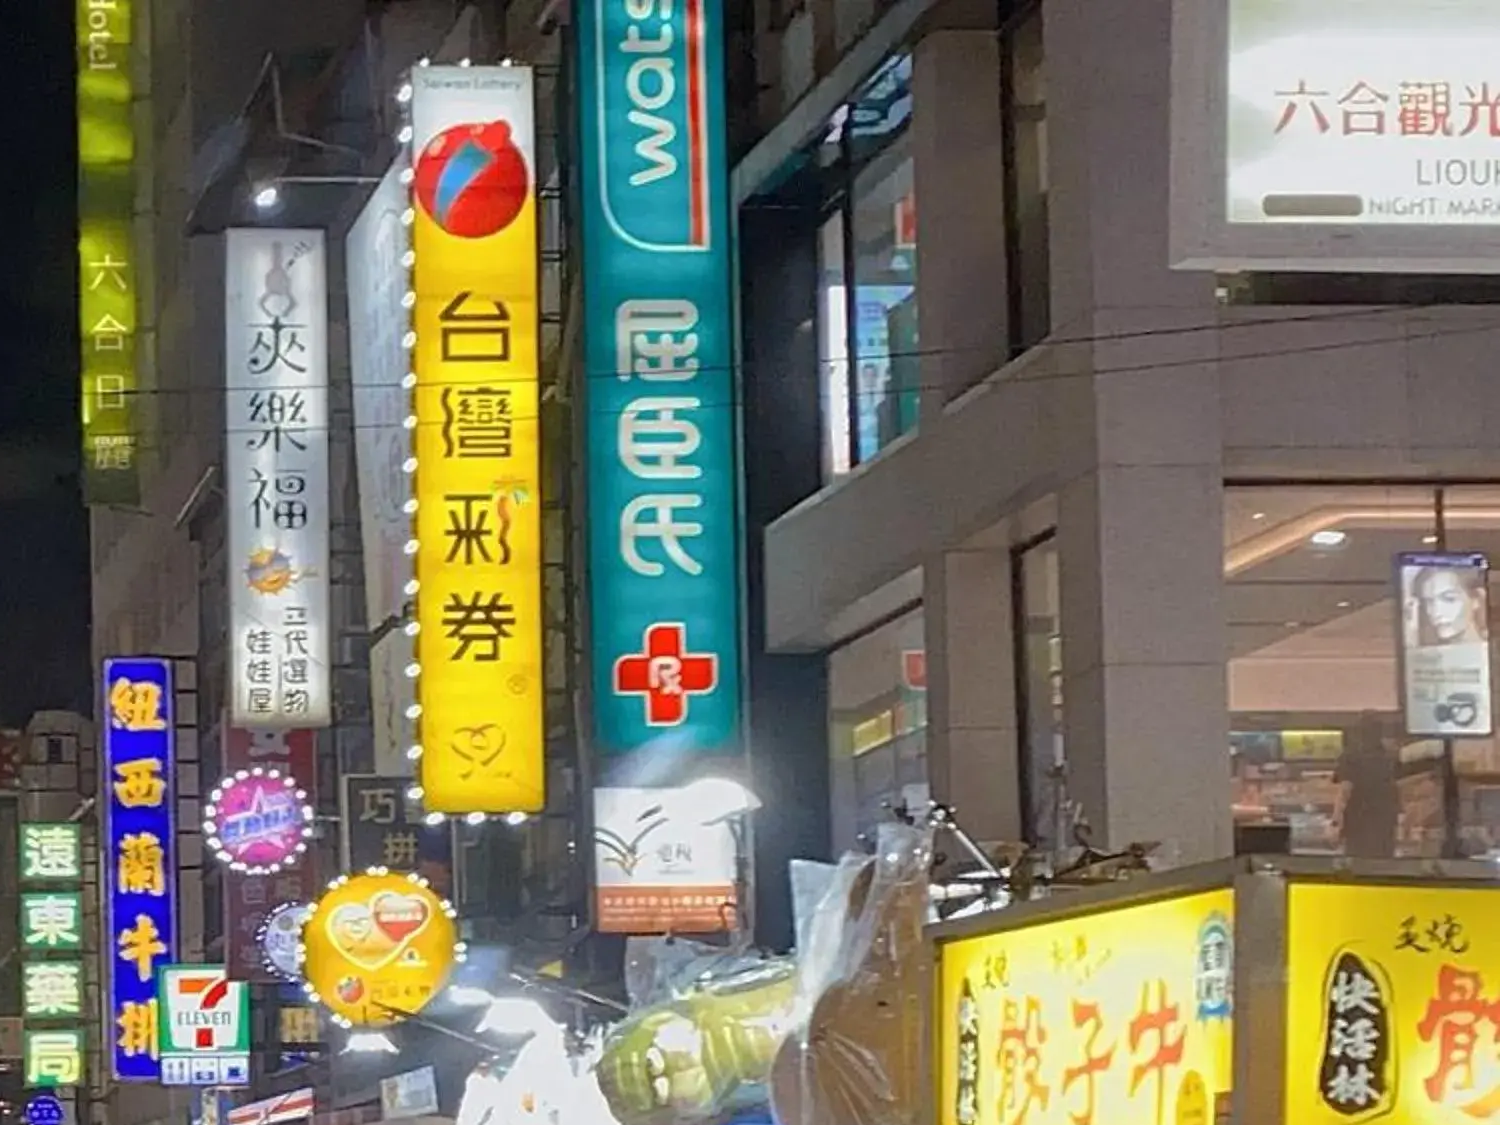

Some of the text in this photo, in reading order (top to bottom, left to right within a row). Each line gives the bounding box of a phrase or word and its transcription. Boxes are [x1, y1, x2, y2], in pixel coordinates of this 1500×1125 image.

[1368, 197, 1437, 215] NIGHT
[615, 299, 703, 577] 屈臣氏
[24, 825, 83, 1084] 遠東藥局
